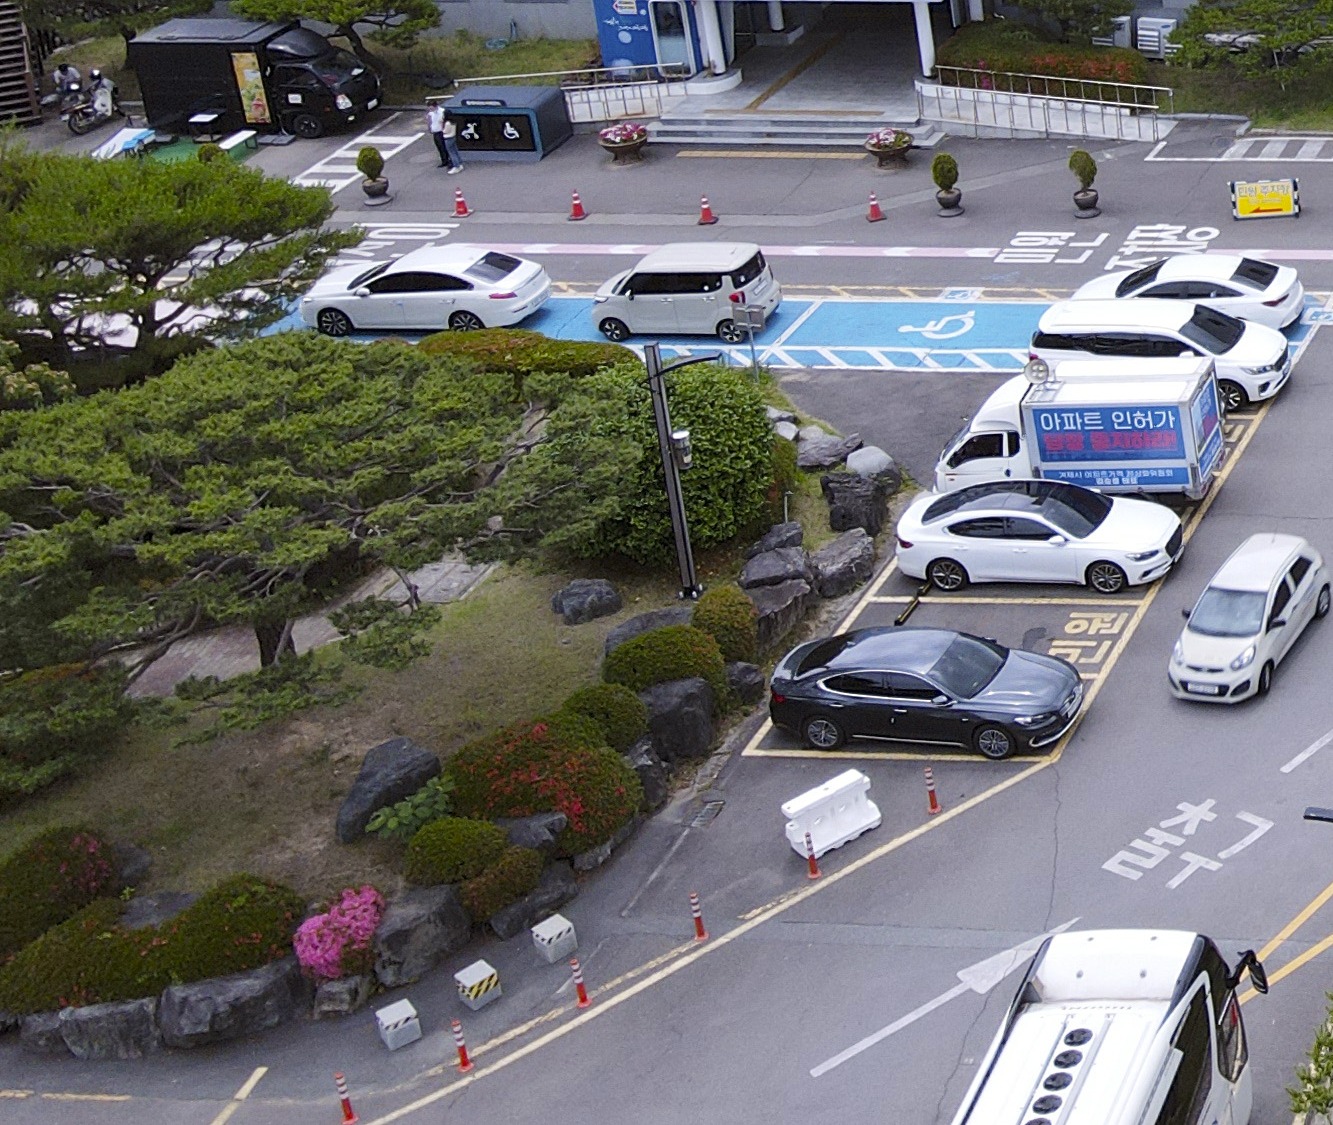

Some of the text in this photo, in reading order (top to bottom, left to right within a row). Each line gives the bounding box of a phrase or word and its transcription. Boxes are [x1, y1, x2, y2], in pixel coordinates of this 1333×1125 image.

[1040, 410, 1176, 431] 아파트 인허가
[1100, 798, 1275, 890] 출구
